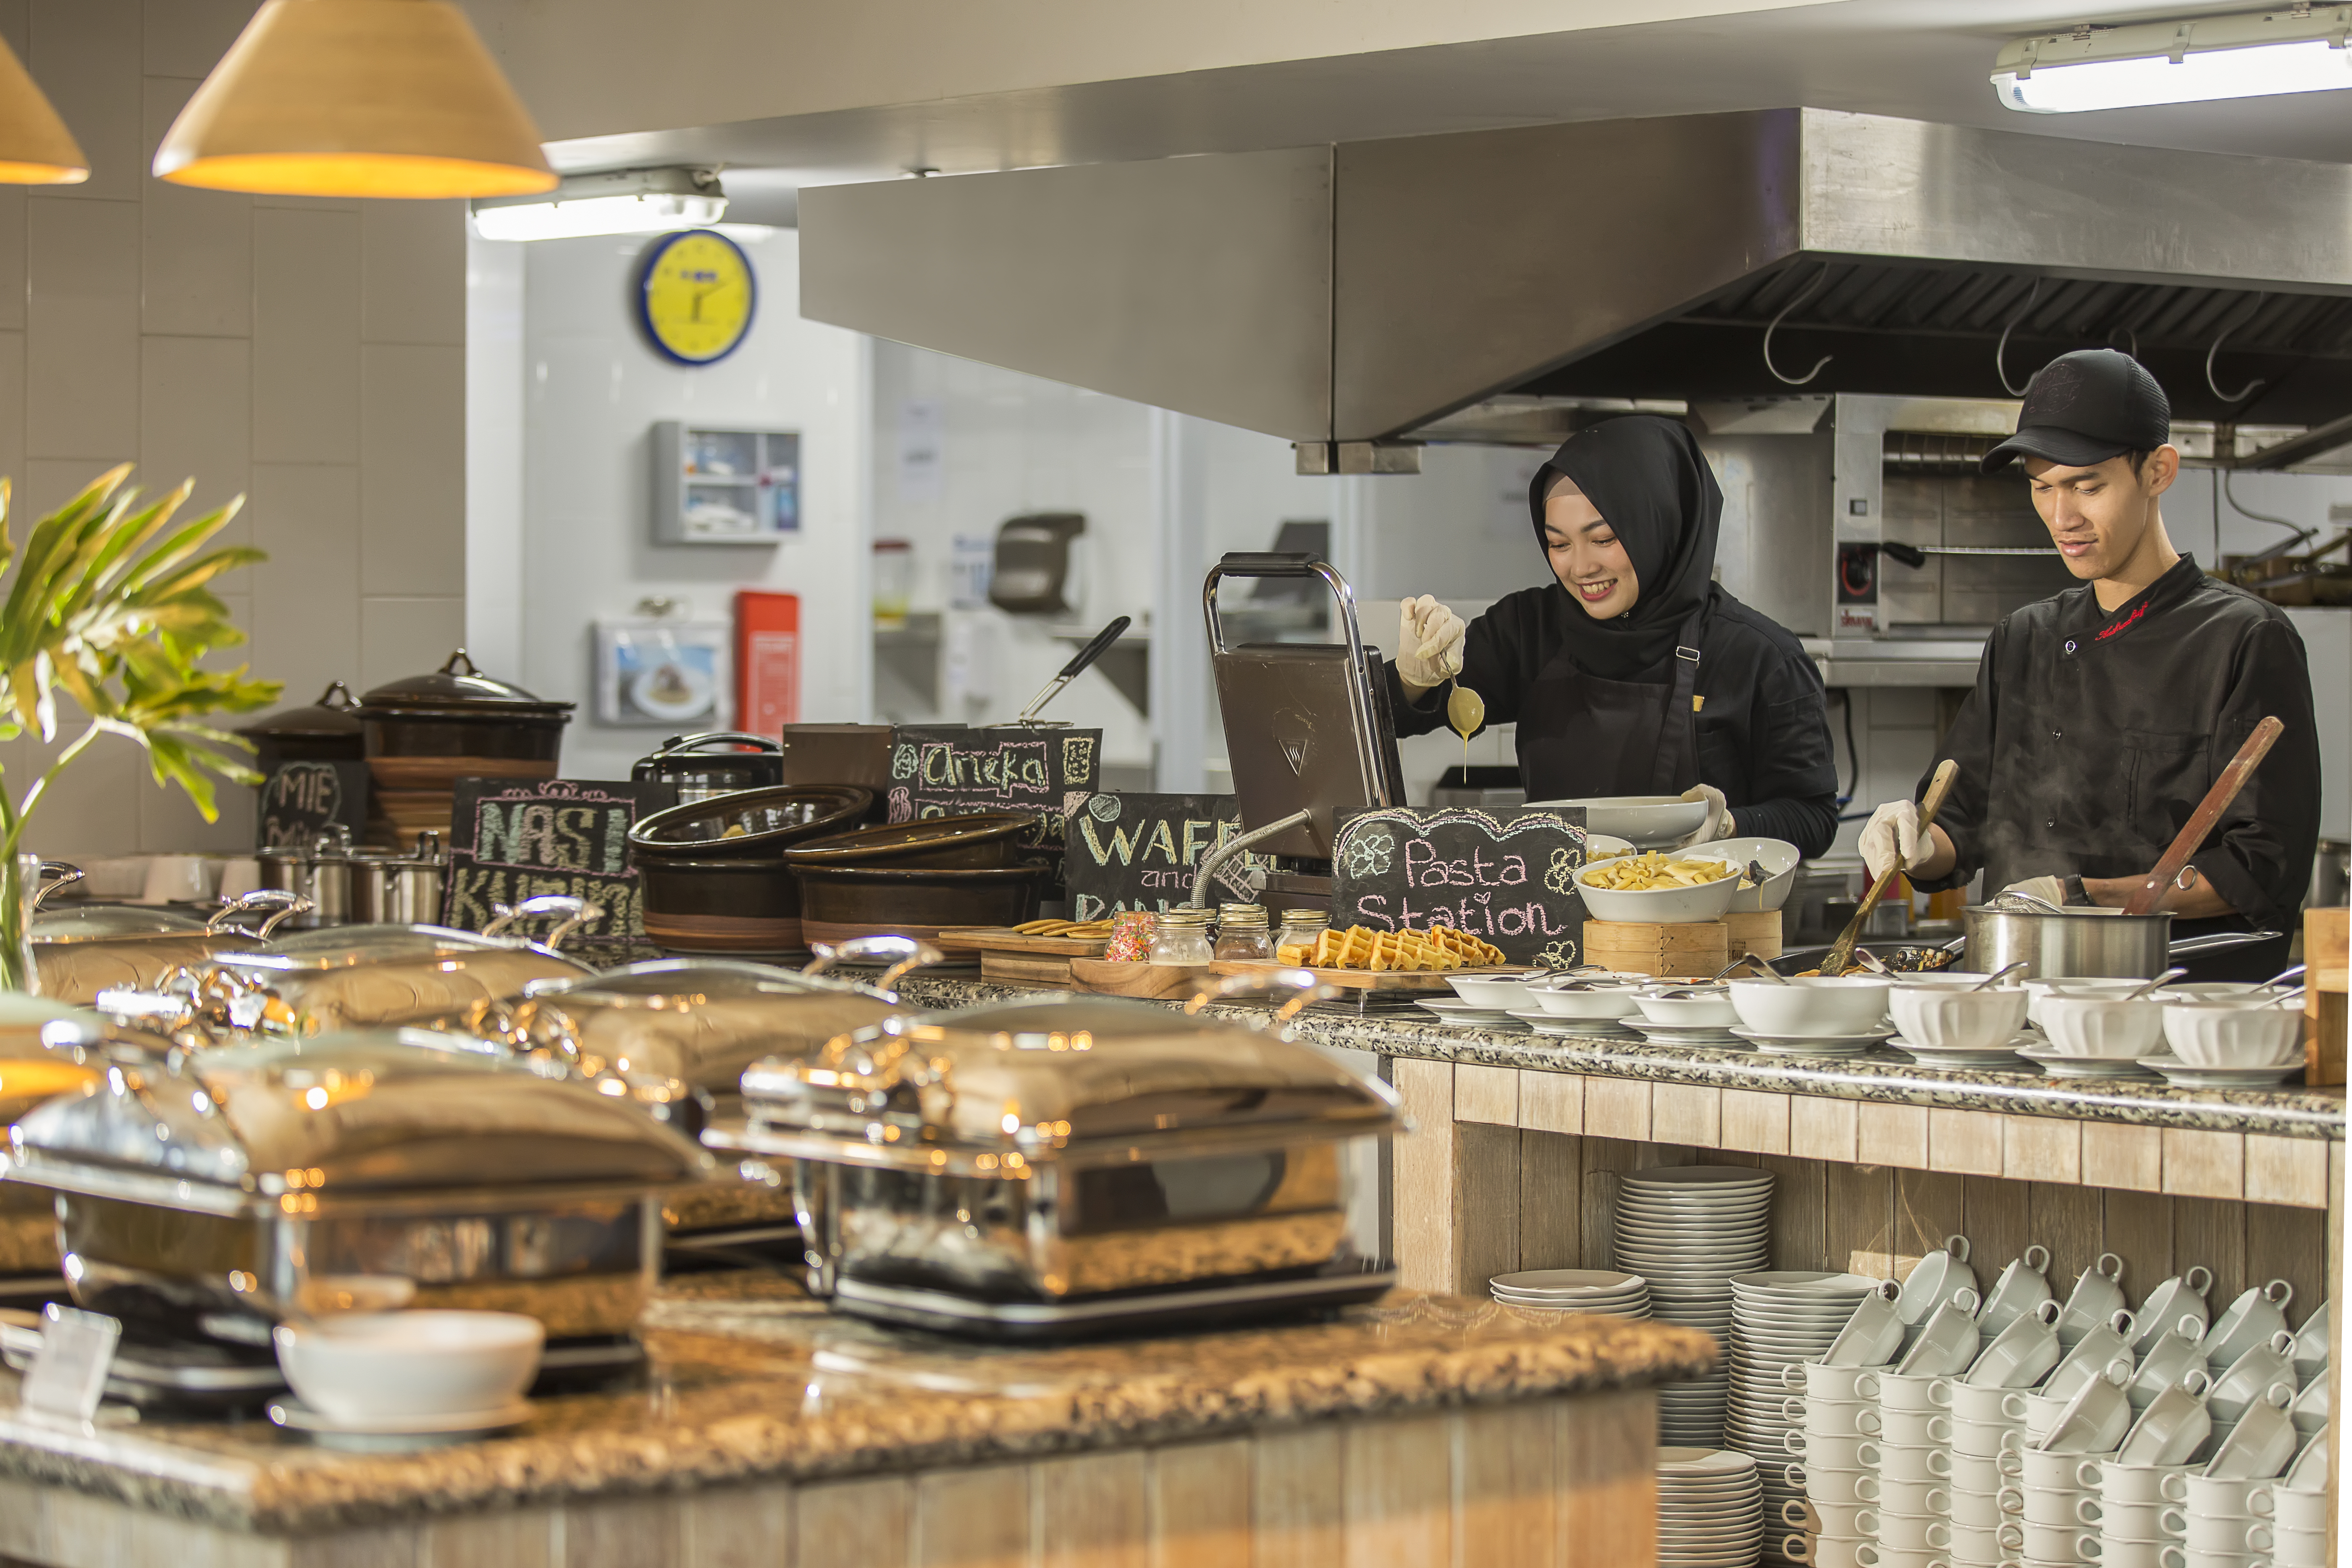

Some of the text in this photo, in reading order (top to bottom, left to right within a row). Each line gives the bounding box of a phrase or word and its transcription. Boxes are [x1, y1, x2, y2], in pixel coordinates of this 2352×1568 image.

[278, 770, 333, 815] MIE
[478, 802, 628, 873] NASI
[1141, 863, 1197, 889] and
[1405, 839, 1528, 888] Pasta
[1357, 891, 1569, 936] Station
